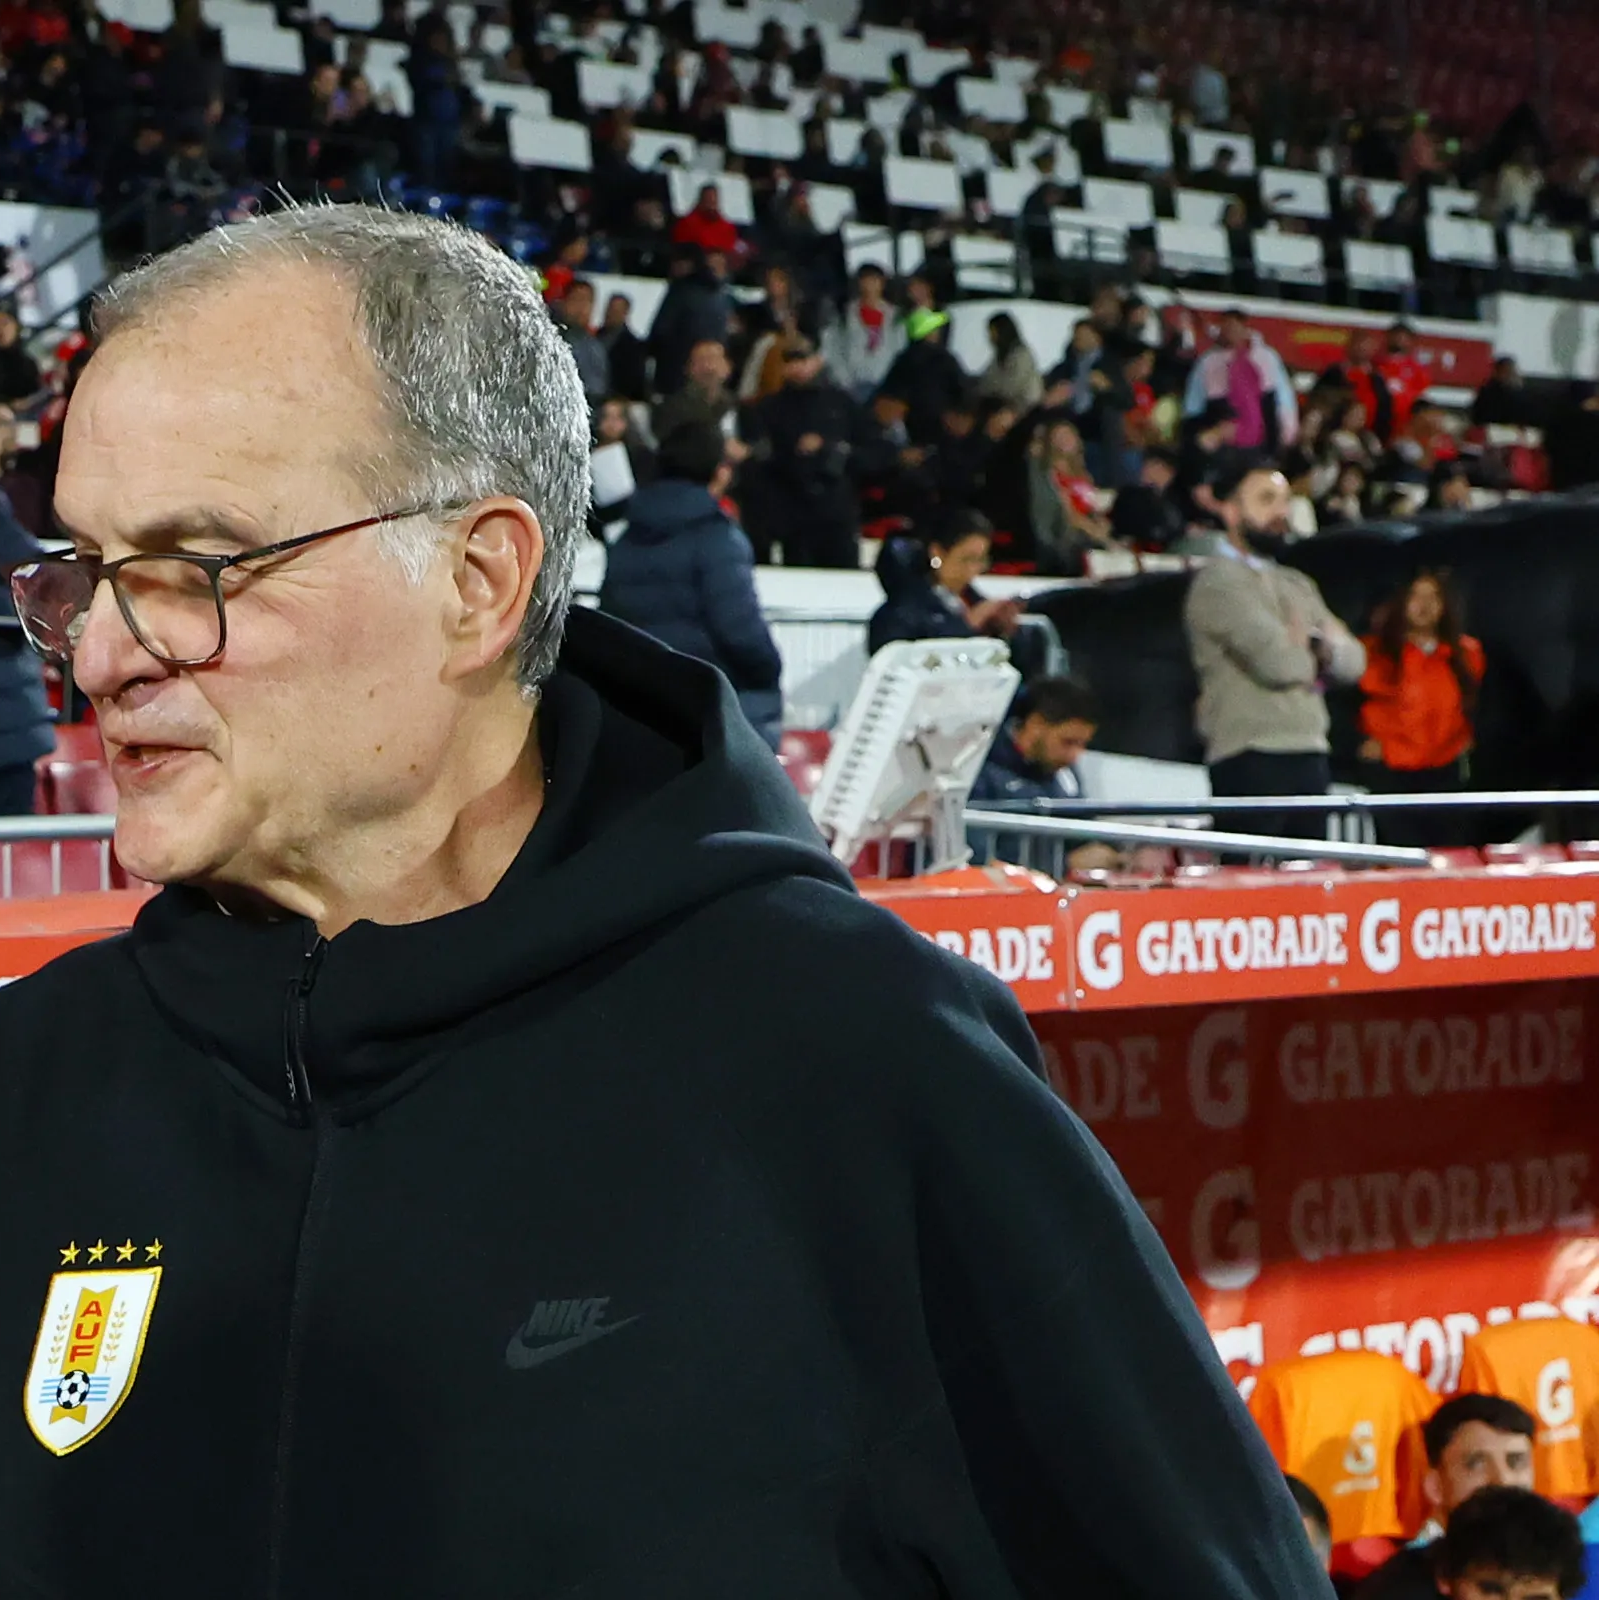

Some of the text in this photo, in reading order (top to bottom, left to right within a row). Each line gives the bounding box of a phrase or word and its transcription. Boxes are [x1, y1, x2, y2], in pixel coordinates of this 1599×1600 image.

[1077, 910, 1124, 990] G
[1136, 912, 1348, 976] GATORADE
[1359, 898, 1401, 974] G
[1411, 900, 1597, 960] GATORADE
[1187, 1008, 1250, 1130] G
[1279, 1006, 1584, 1103] GATORADE
[1189, 1152, 1597, 1291] G GATORADE
[69, 1300, 103, 1363] AUF
[523, 1296, 610, 1337] NIKE
